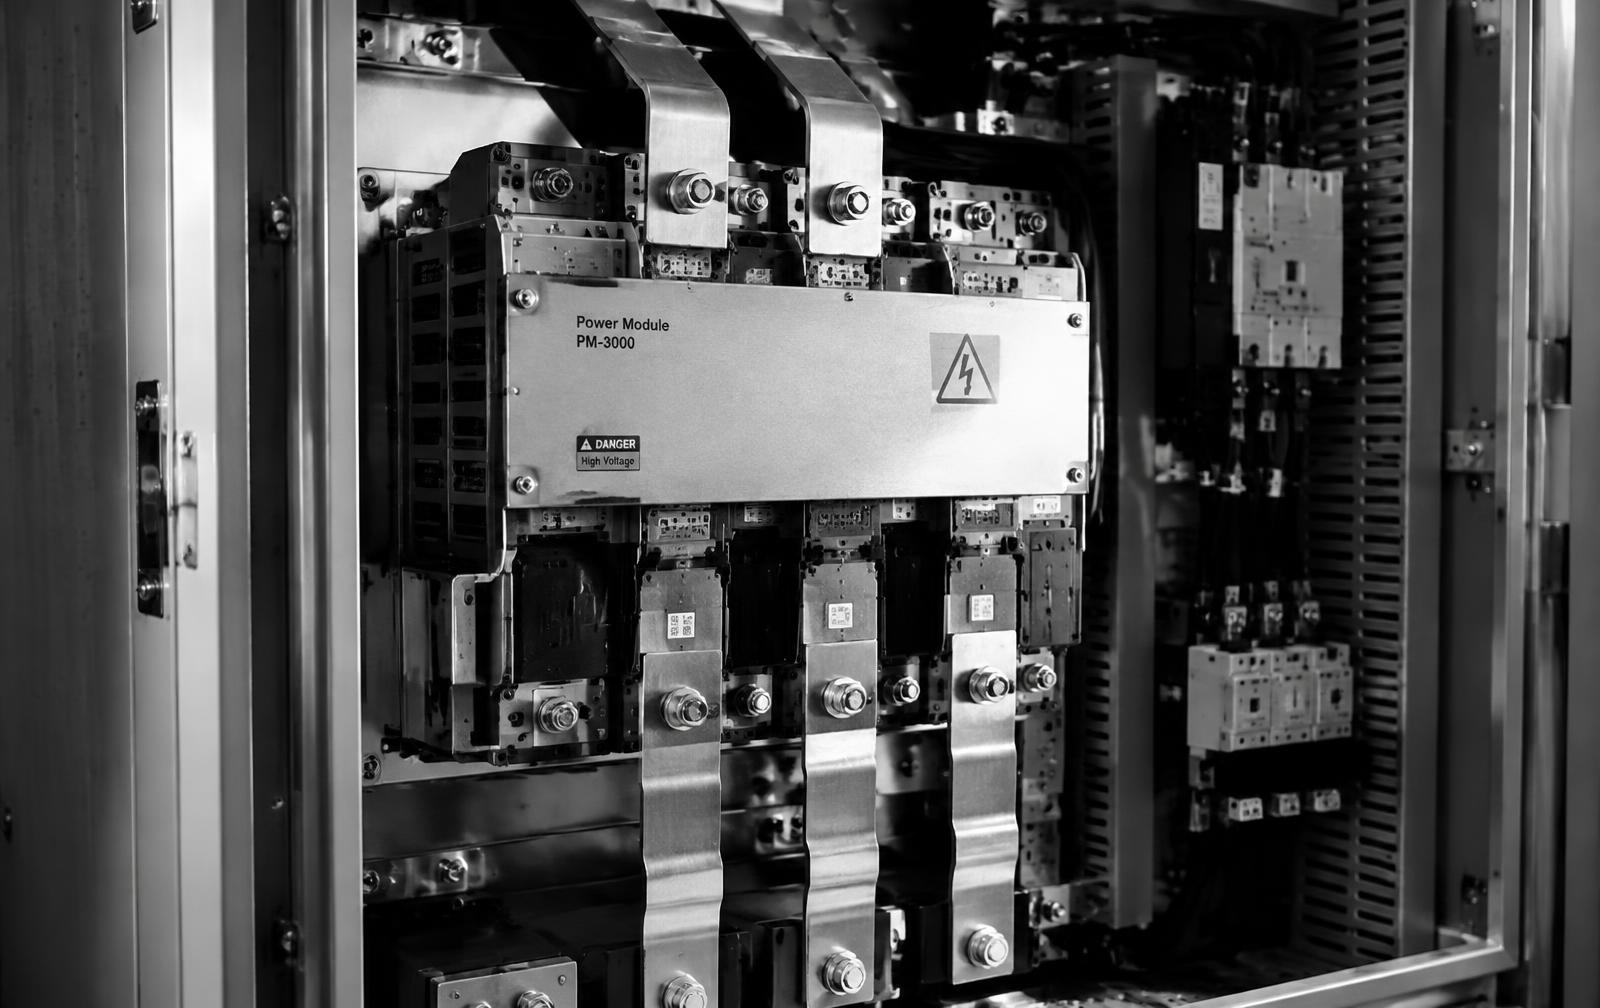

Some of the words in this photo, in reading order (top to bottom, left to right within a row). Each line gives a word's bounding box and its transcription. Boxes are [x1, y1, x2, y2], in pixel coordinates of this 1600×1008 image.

[576, 315, 618, 329] Power
[622, 317, 670, 331] Module
[576, 335, 635, 349] PM-3000
[595, 439, 636, 450] DANGER
[581, 456, 601, 467] High
[603, 456, 635, 468] Voltage
